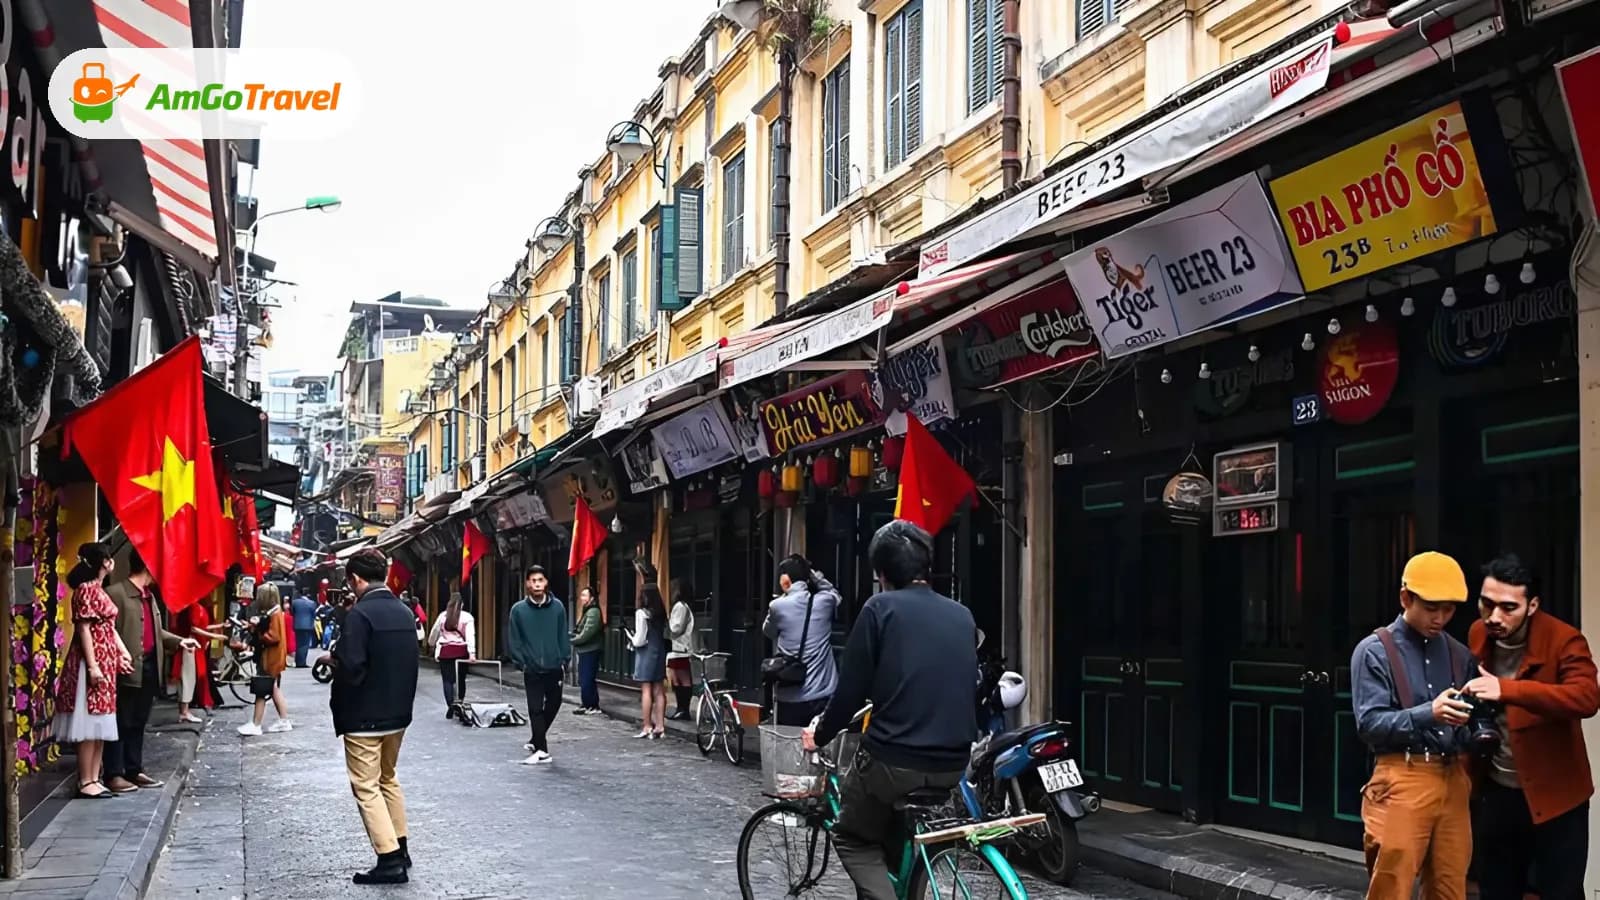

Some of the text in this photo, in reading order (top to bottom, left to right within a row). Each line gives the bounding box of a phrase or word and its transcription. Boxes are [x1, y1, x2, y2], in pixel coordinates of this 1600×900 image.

[1096, 153, 1125, 187] 23
[1288, 195, 1347, 247] BIA
[1342, 143, 1412, 226] PHỐ
[1165, 248, 1227, 296] BEER
[1220, 235, 1256, 277] 23
[1323, 236, 1372, 275] 23B
[1096, 282, 1160, 330] Tiger
[1296, 400, 1317, 420] 23
